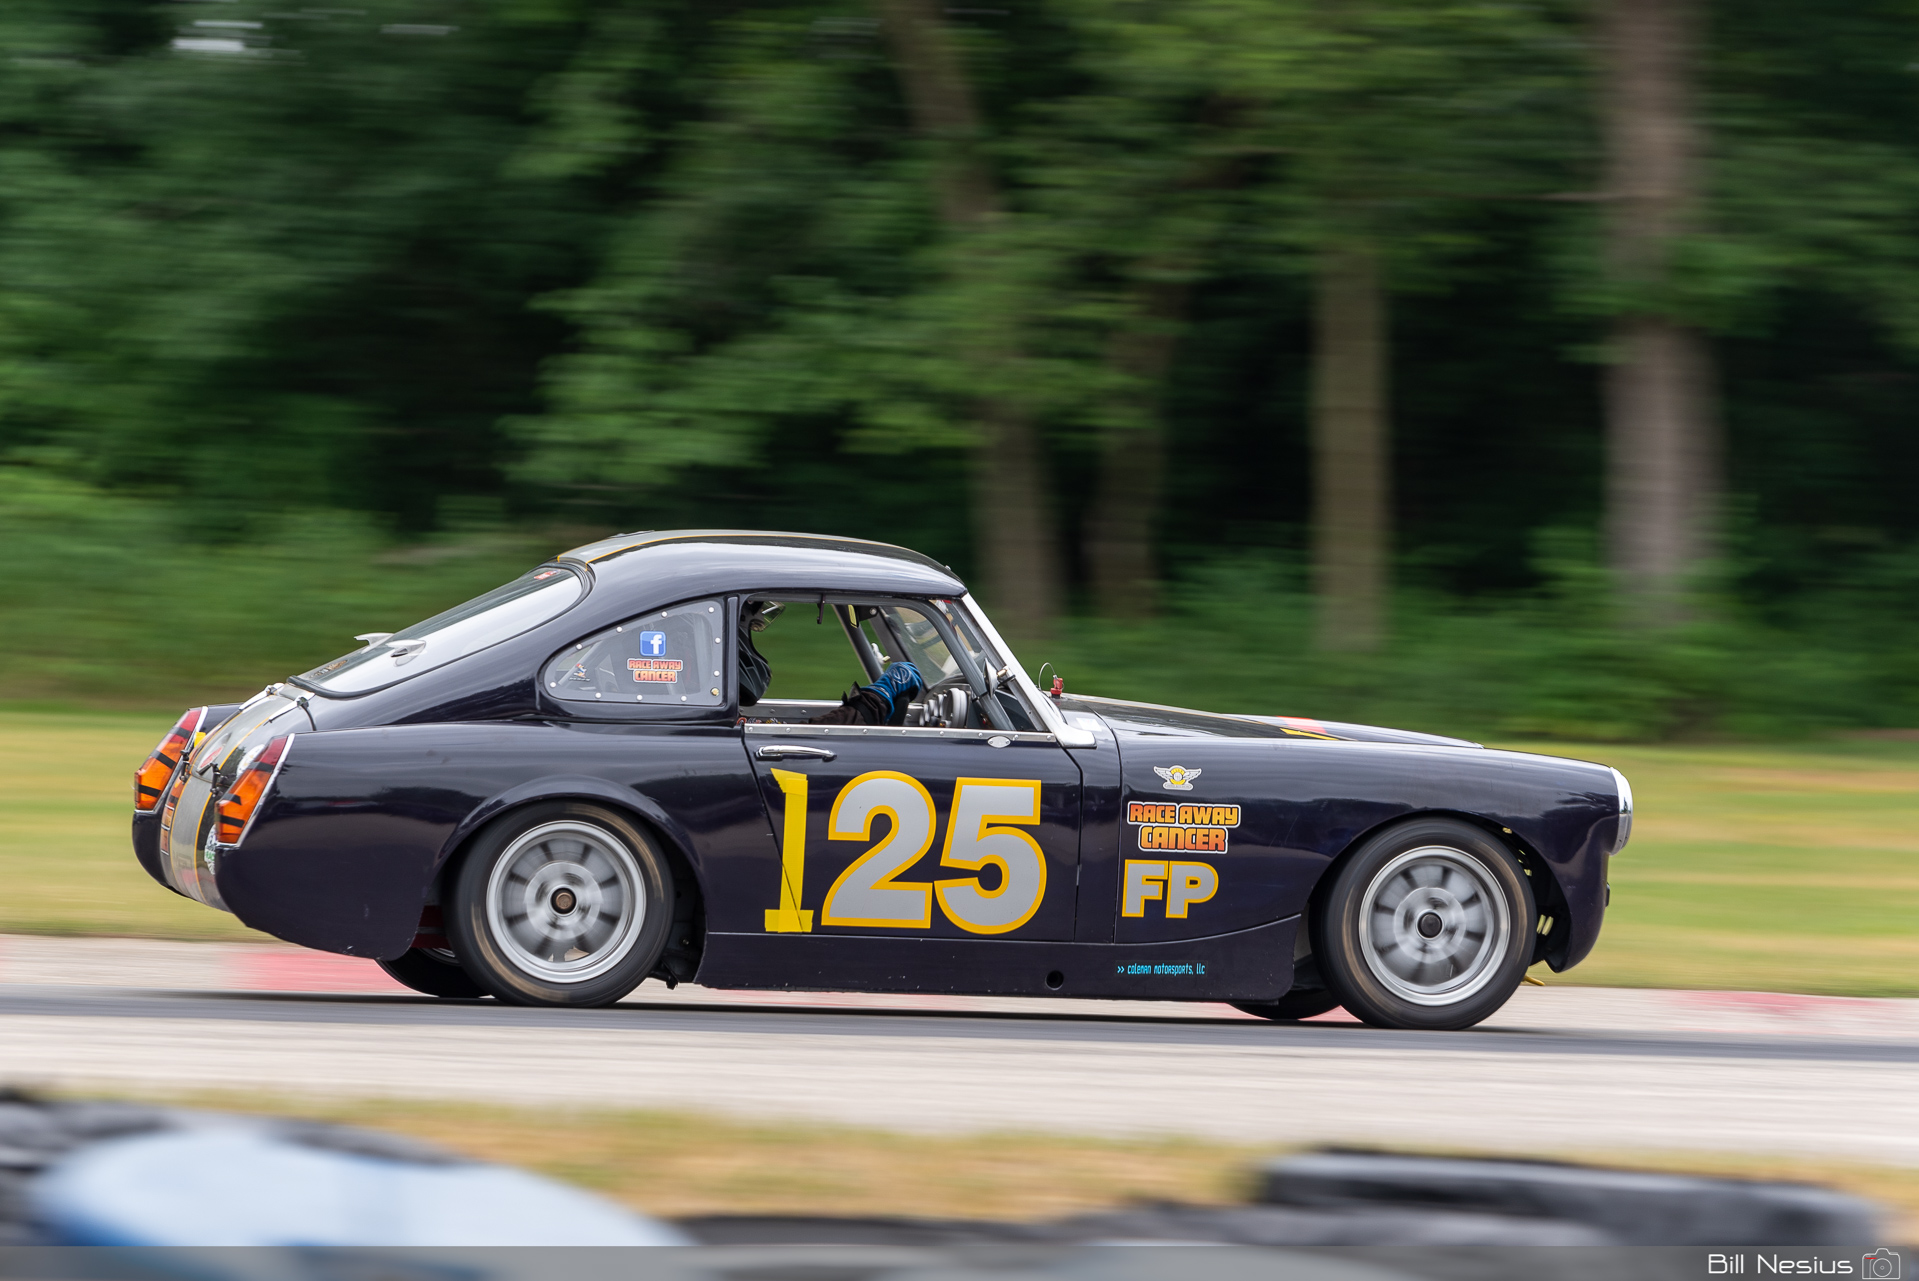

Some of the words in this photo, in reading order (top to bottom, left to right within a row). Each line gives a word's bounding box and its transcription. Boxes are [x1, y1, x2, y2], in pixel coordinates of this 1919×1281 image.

[628, 659, 652, 669] RACE
[652, 660, 682, 671] AWAY
[634, 670, 676, 682] CANCER
[1129, 803, 1177, 824] RACE
[1178, 805, 1239, 826] AWAY
[1140, 825, 1226, 851] CANCER
[765, 768, 1047, 935] 125
[1122, 859, 1219, 919] FP
